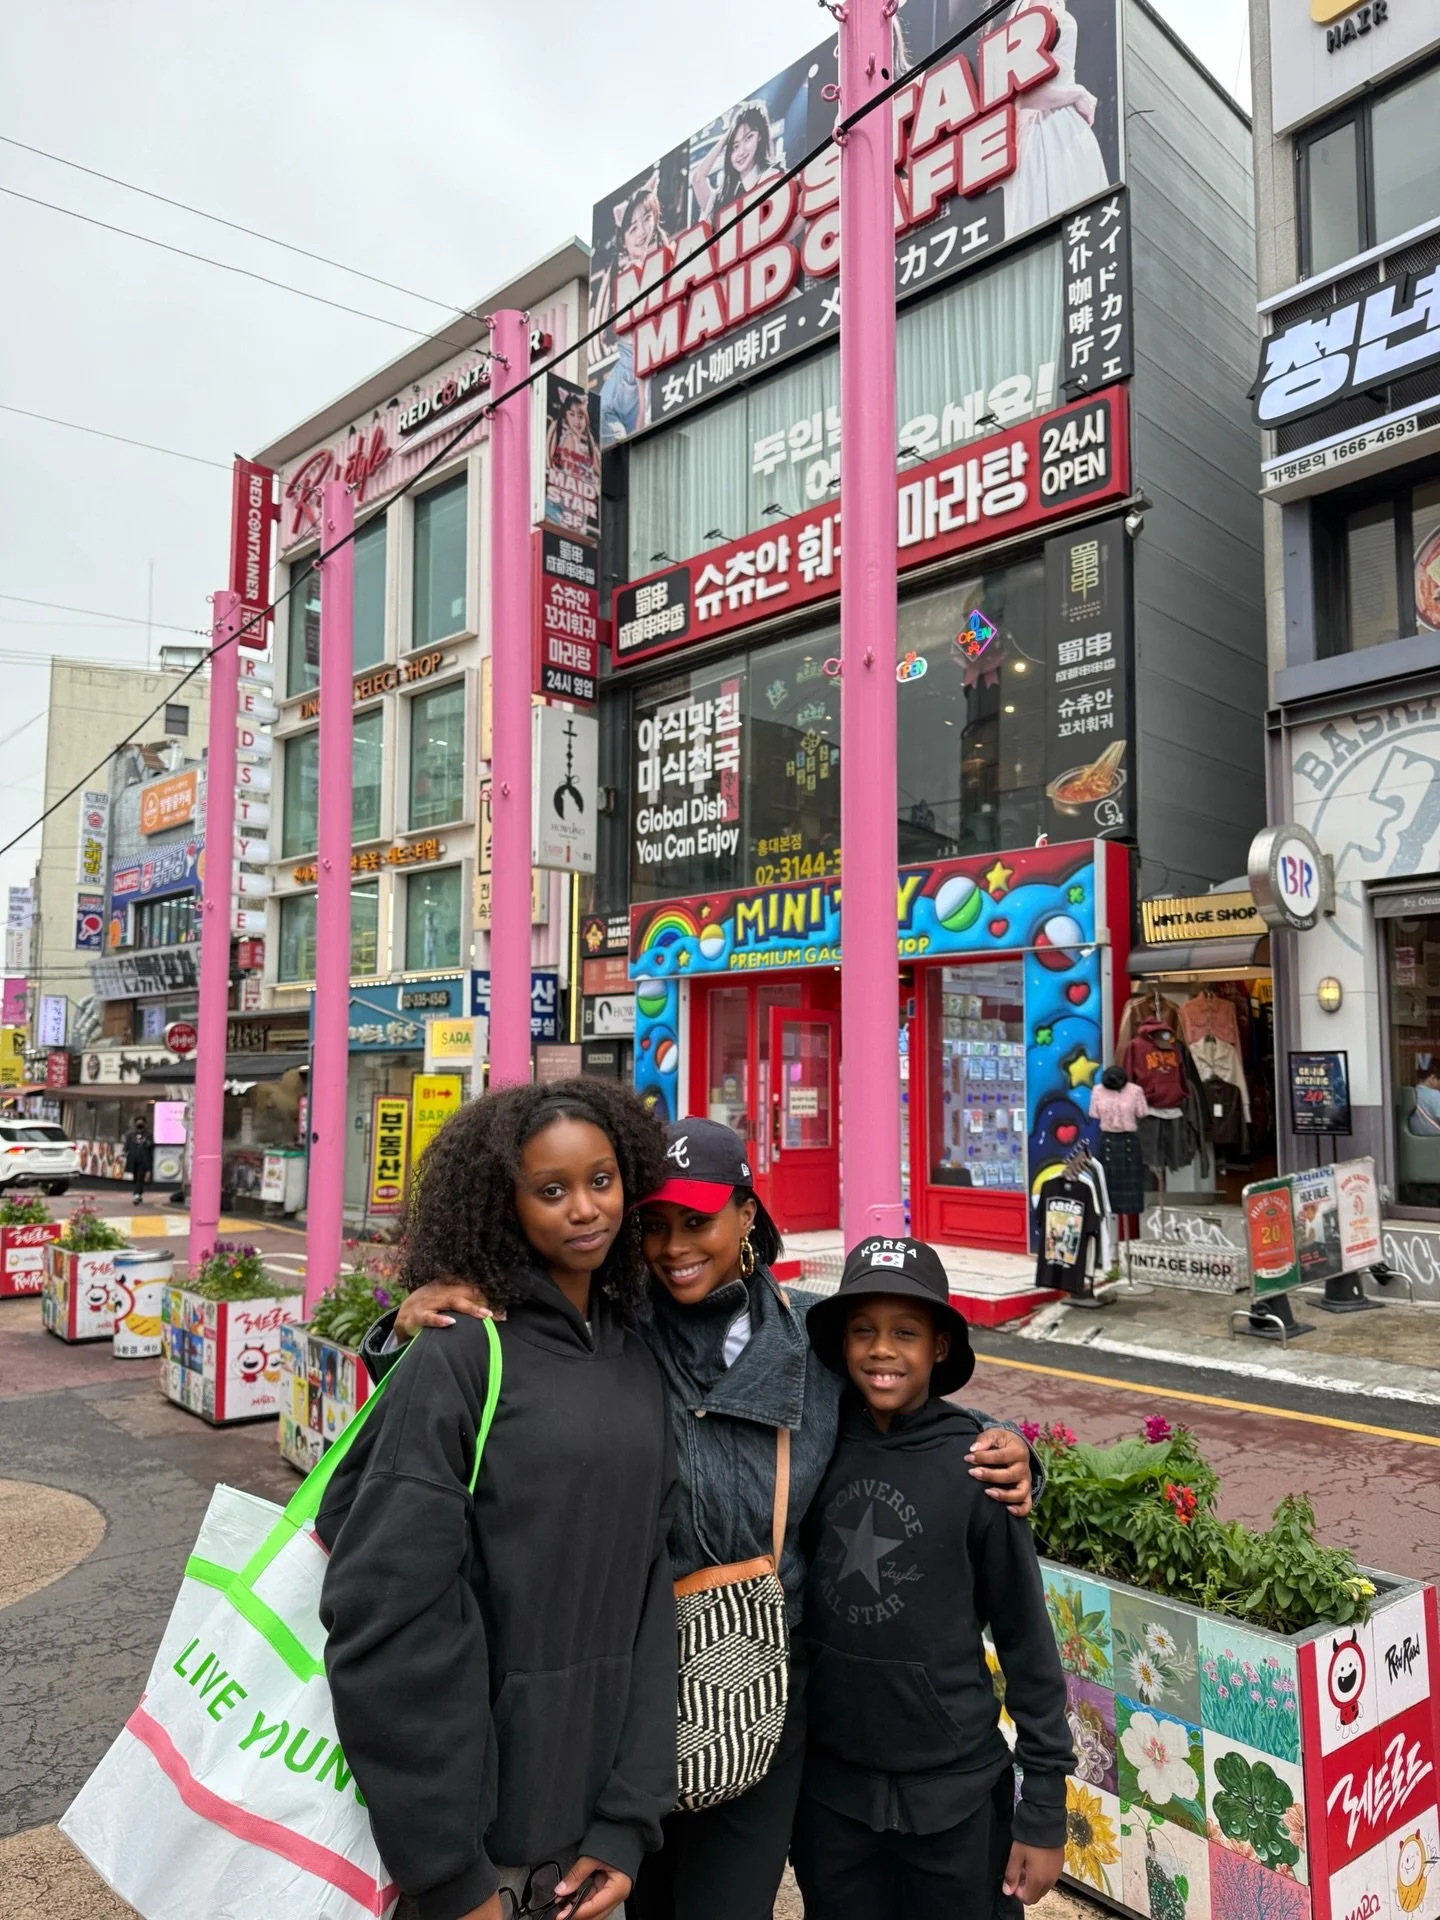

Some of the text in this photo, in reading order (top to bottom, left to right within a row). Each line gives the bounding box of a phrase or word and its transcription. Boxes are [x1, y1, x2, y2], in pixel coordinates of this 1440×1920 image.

[1326, 1, 1389, 54] HAIR
[614, 172, 799, 334] MAID
[634, 103, 1016, 378] MAID CFE
[1067, 215, 1095, 369] 女仆咖啡厅
[1098, 196, 1123, 381] メイドカフェ
[661, 313, 787, 412] 女仆咖啡厅
[397, 402, 431, 433] RED
[898, 362, 1055, 466] 오세요!
[1042, 408, 1105, 464] 24시
[1269, 420, 1416, 483] 가맹문의 1666-4693
[549, 468, 596, 500] MAID
[1041, 447, 1107, 496] OPEN
[547, 485, 598, 519] STAR
[694, 440, 1029, 622] 슈츄안 훠 마라탕
[245, 508, 261, 601] CONTAINER
[551, 582, 591, 614] 슈츄안
[548, 638, 592, 672] 마라탕
[546, 670, 594, 699] 24시 영업
[1056, 688, 1114, 719] 슈츄안
[637, 692, 740, 752] 야식맛집
[1056, 712, 1115, 738] 꼬치훠궈
[637, 736, 741, 794] 미식천국
[636, 793, 728, 835] Global Dish
[1106, 812, 1124, 826] 24
[636, 825, 740, 864] You Can Enjoy
[757, 834, 803, 857] 홍대본점
[755, 848, 842, 887] 02-3144-3
[1280, 855, 1313, 899] BR
[736, 886, 822, 942] MINI
[1152, 907, 1258, 927] VINTAGE SHOP
[729, 950, 801, 970] PREMIUM
[804, 946, 842, 964] GAC
[441, 1031, 472, 1046] SARA
[422, 1088, 436, 1099] B1
[378, 1112, 403, 1181] 부동산
[1049, 1200, 1083, 1215] oasis
[860, 1239, 918, 1259] KOREA
[1261, 1224, 1280, 1244] 20
[1190, 1260, 1232, 1277] SHOP
[824, 1478, 924, 1538] CONVERSE
[881, 1560, 925, 1592] Taylor
[847, 1590, 906, 1625] STAR
[172, 1637, 370, 1810] LIVE YOUN
